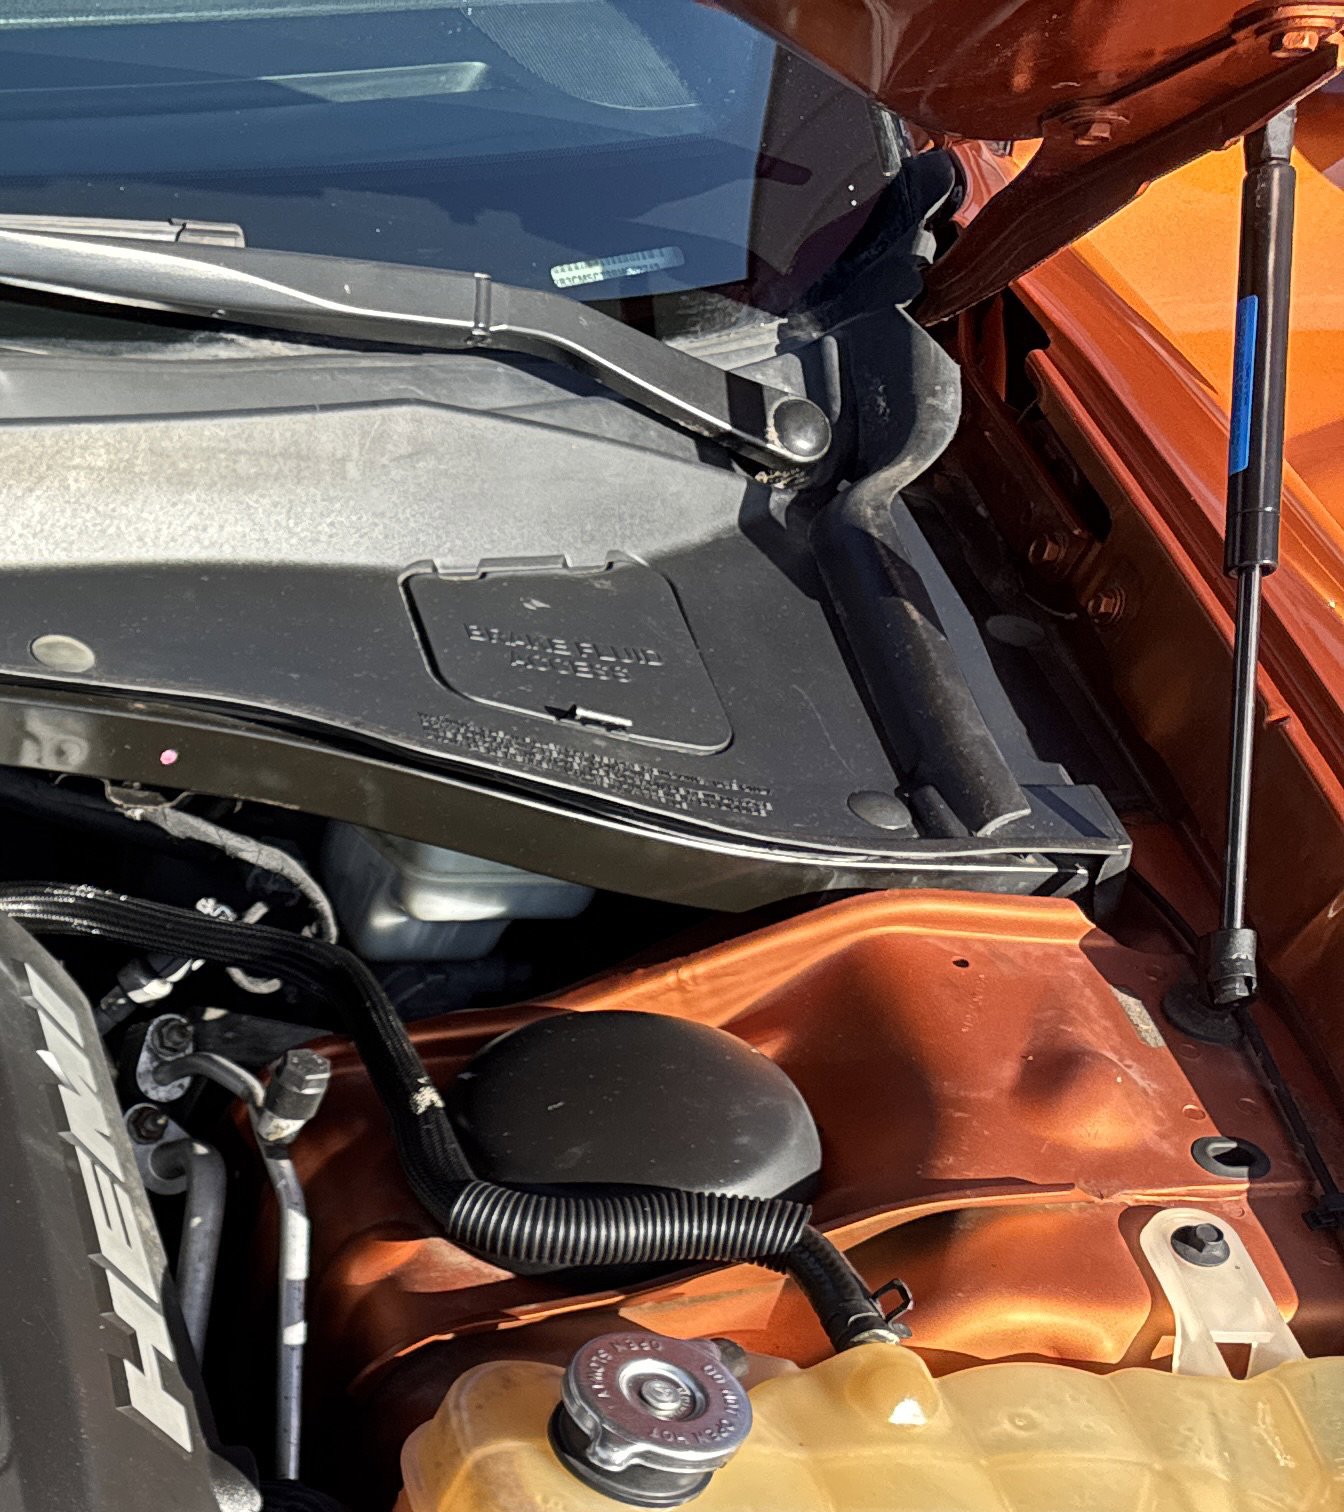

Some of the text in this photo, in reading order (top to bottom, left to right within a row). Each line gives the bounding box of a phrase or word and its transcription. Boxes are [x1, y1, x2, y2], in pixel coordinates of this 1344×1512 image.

[464, 622, 663, 667] BRAKE FLUID
[511, 655, 633, 684] ACCESS
[23, 961, 194, 1453] HEMI
